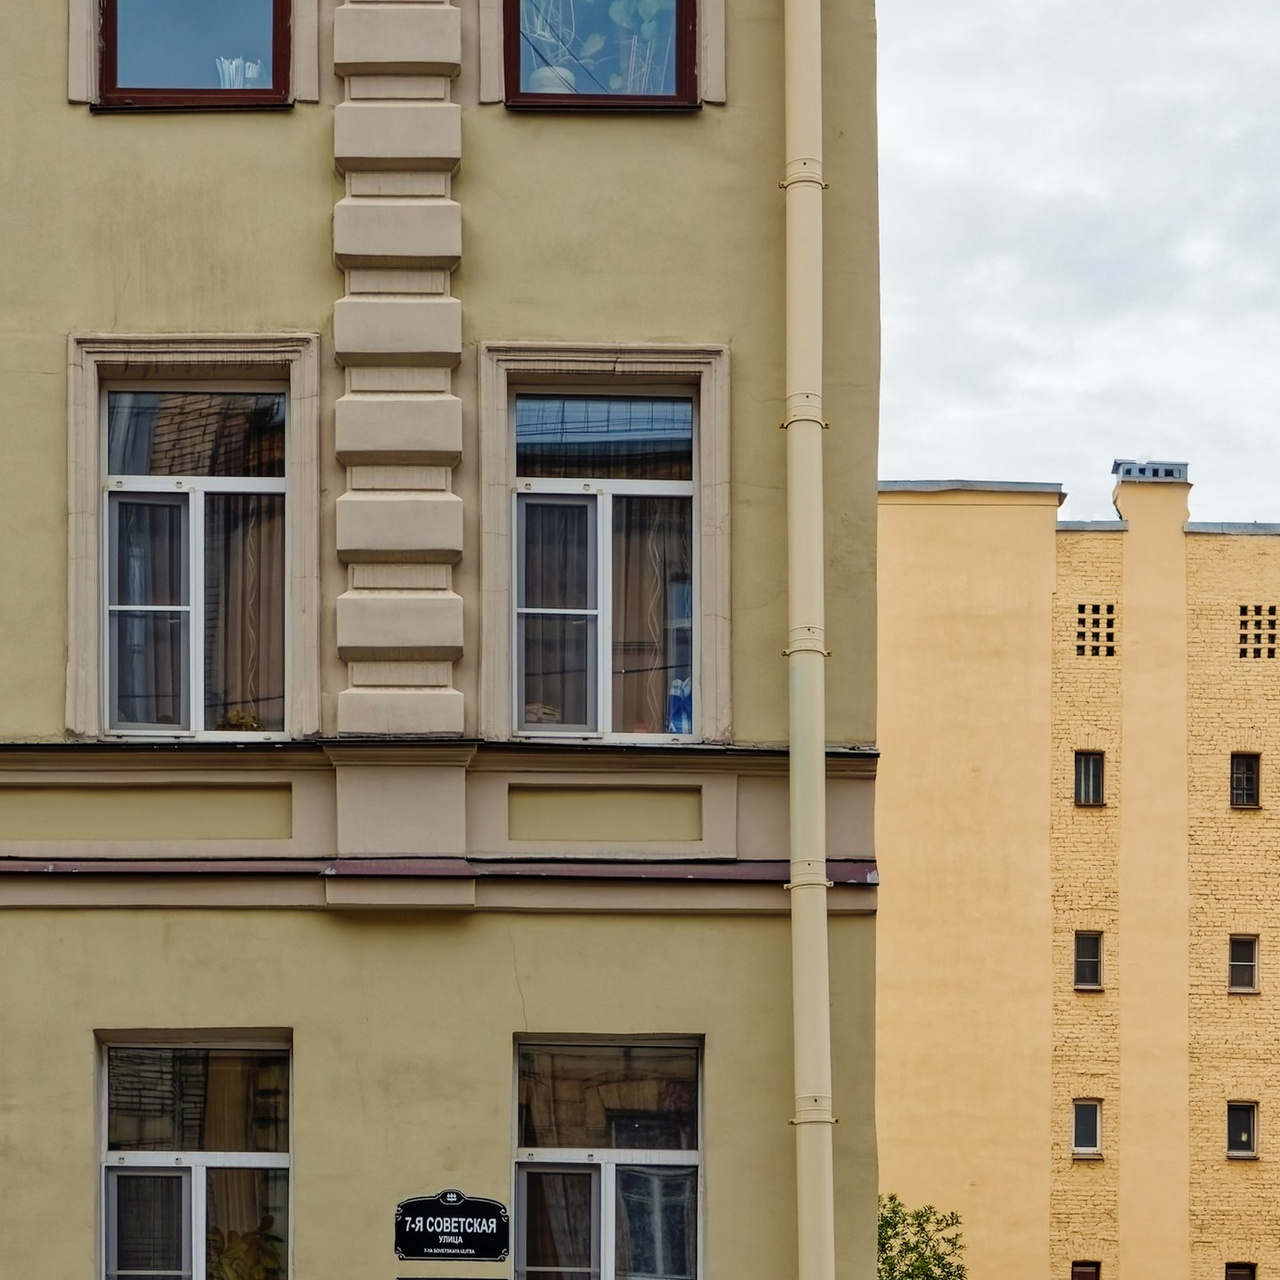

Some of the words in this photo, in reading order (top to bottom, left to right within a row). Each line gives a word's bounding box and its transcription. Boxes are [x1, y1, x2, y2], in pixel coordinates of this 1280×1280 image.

[405, 1217, 423, 1232] 7-Я
[426, 1217, 496, 1233] СОВЕТСКАЯ
[438, 1235, 463, 1245] УЛИЦА
